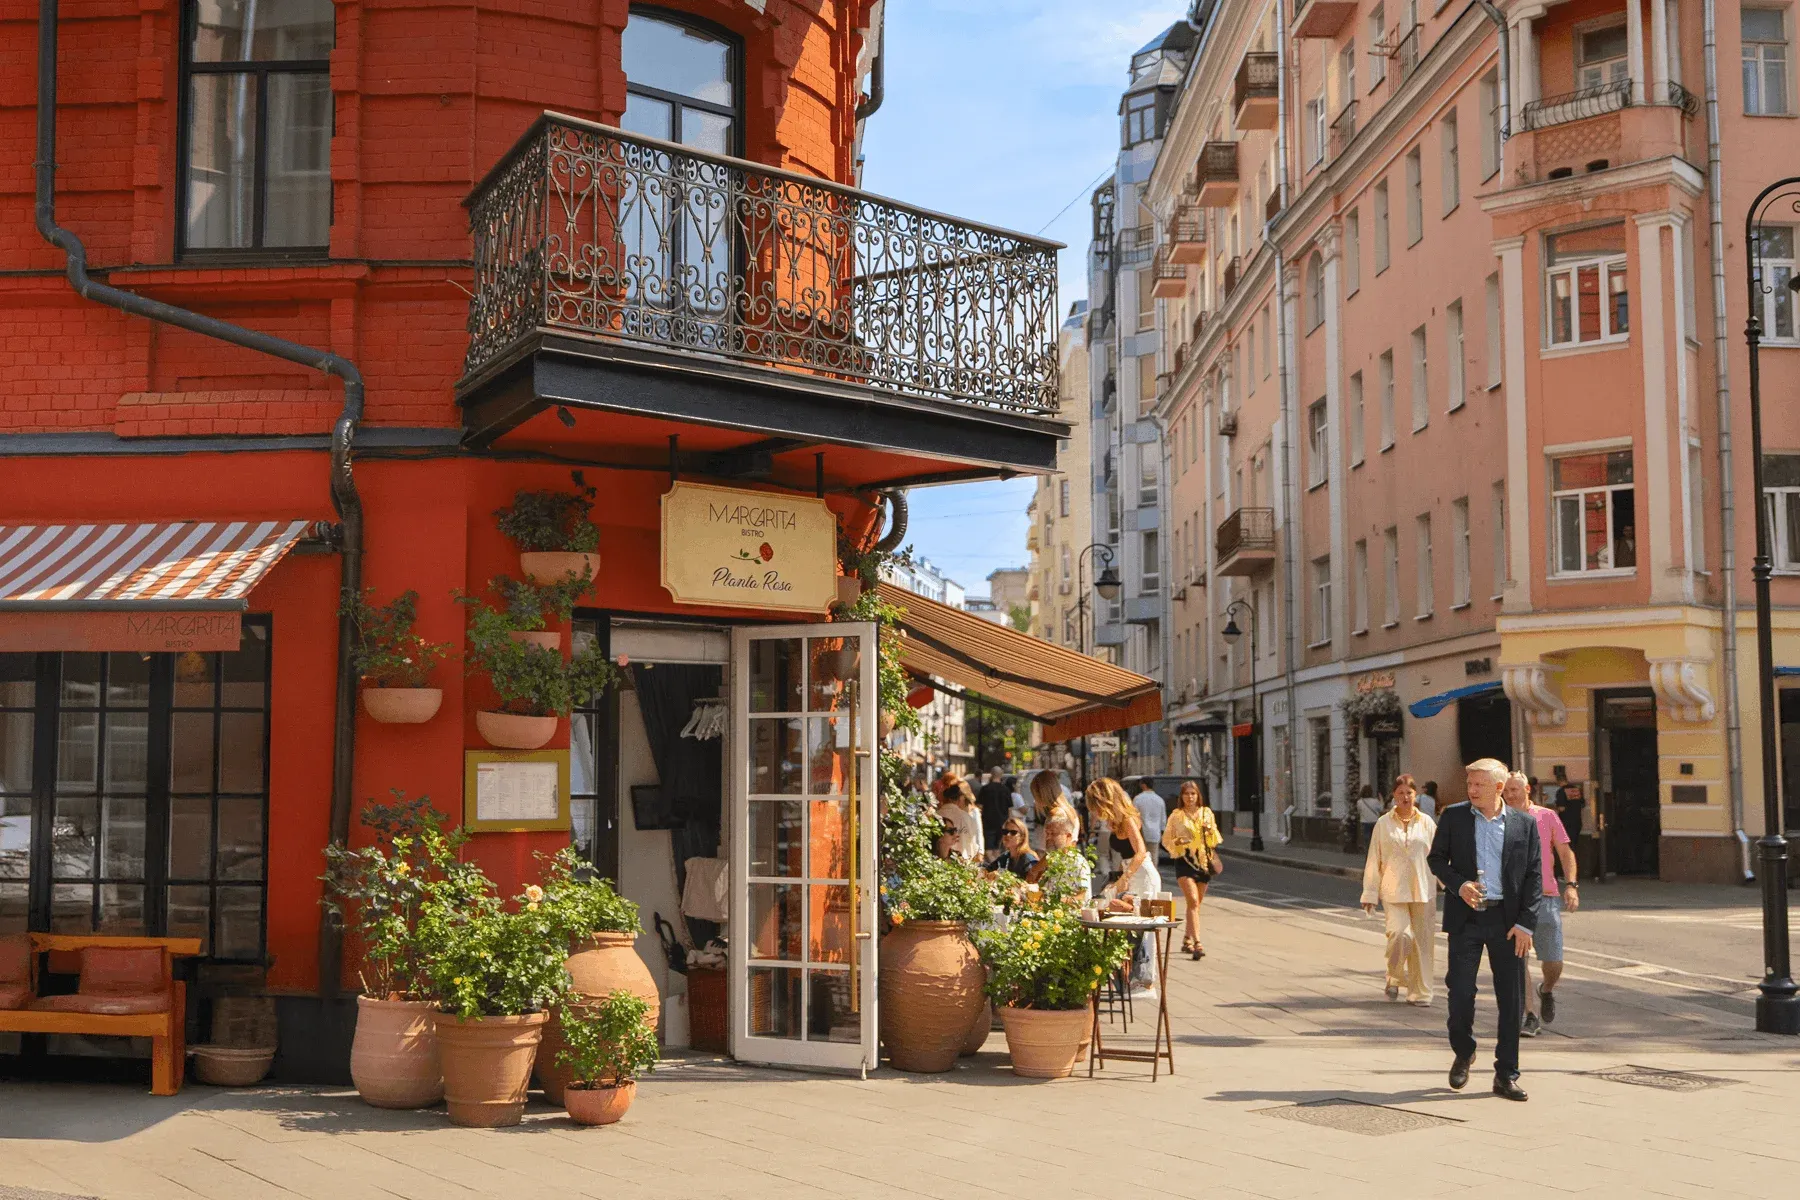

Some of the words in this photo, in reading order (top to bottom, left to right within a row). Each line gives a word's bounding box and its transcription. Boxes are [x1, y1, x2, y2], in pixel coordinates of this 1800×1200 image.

[709, 502, 796, 530] MARGARITA
[741, 528, 764, 538] BISTRO
[711, 567, 759, 588] Planta
[762, 570, 793, 592] Rosa
[126, 616, 236, 635] MARGARITA
[165, 640, 194, 648] BISTRO
